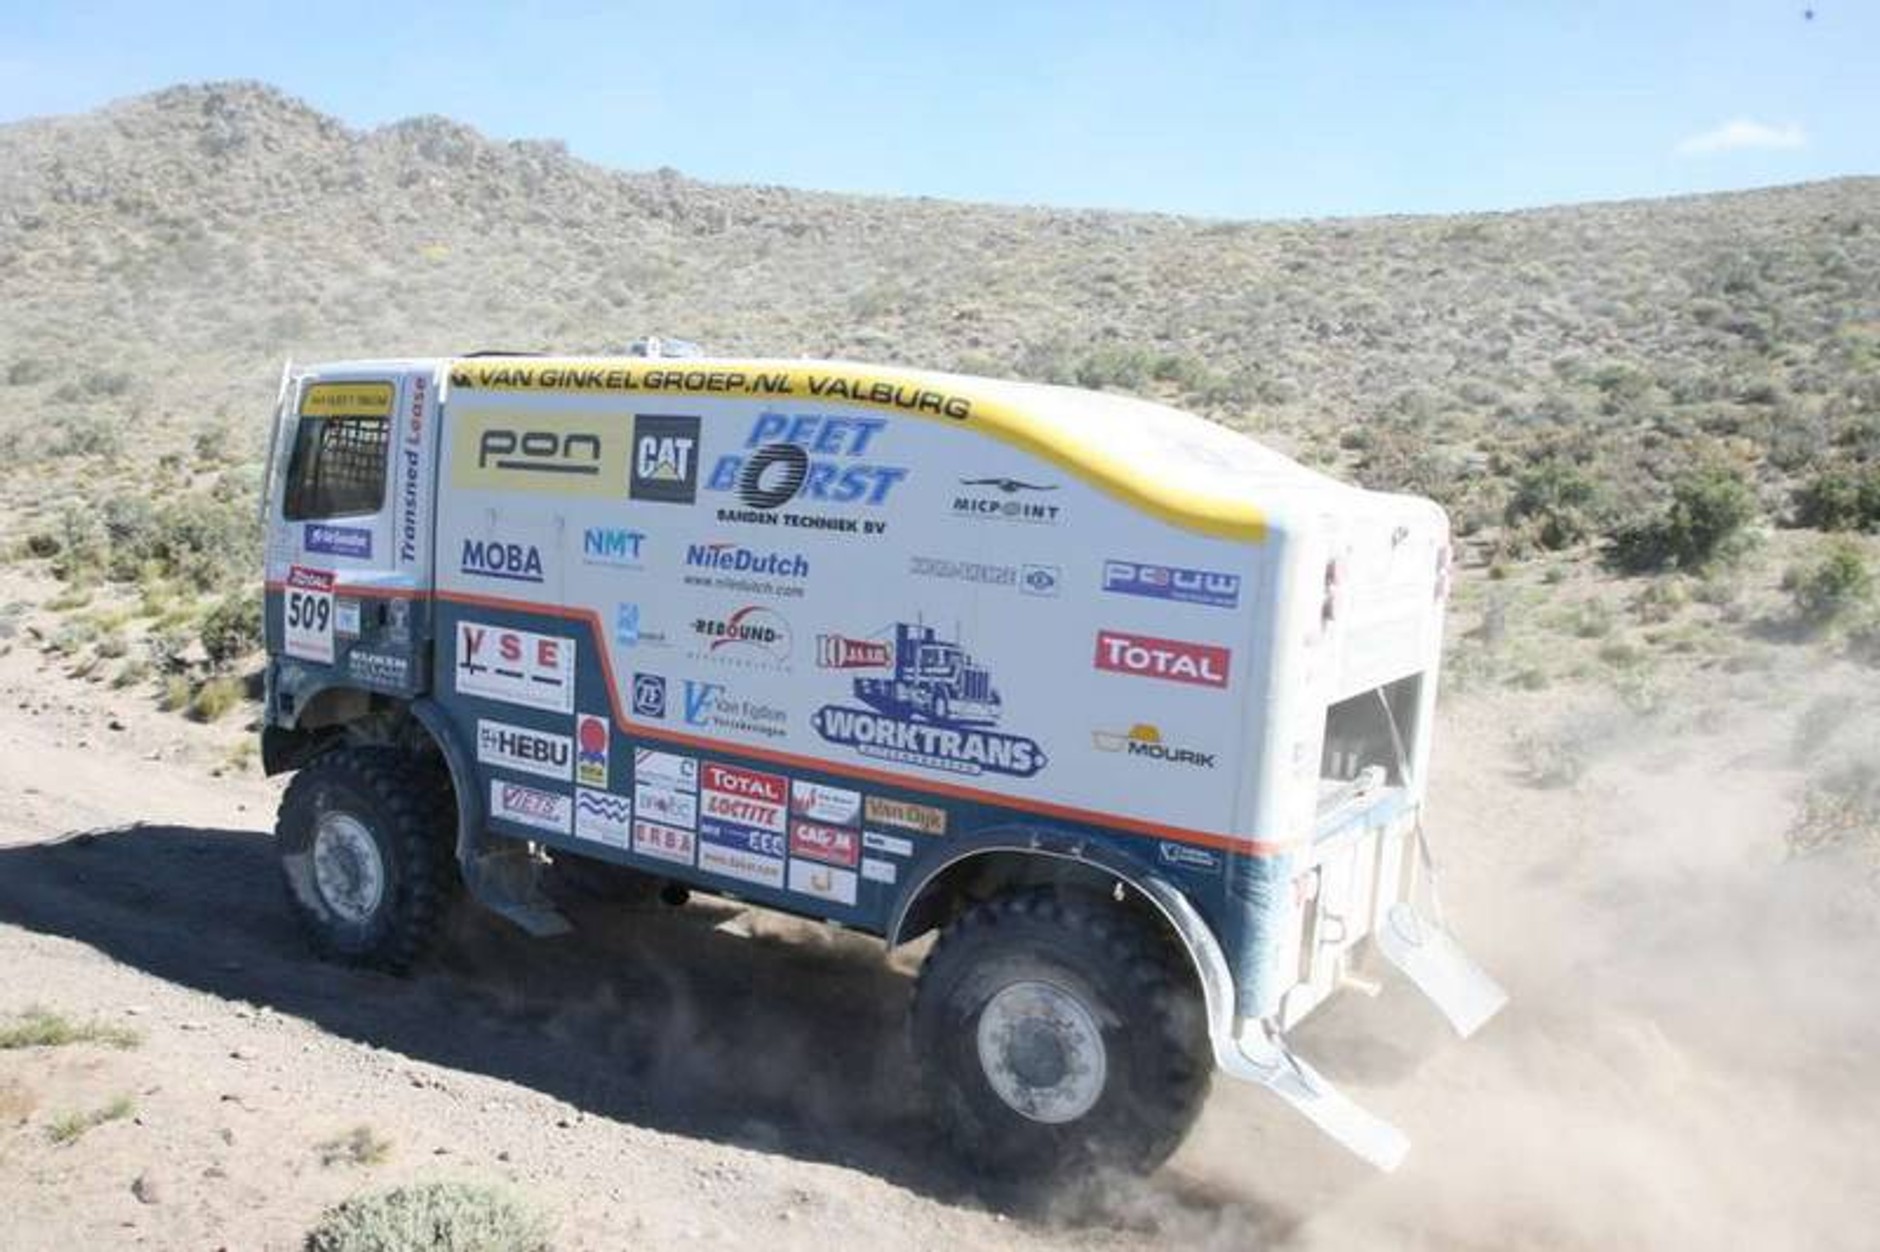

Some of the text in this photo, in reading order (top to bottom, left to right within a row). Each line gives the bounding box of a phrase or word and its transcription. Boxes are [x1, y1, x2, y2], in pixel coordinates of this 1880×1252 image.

[480, 369, 972, 420] VAN GINKEL GROEP.NL VALBURG
[747, 411, 887, 455] PEET
[402, 377, 426, 563] Transned Lease
[637, 436, 694, 482] CAT
[716, 509, 887, 534] BANDEN TECHNIEK BV
[463, 539, 543, 575] MOBA
[584, 529, 646, 557] NMT
[686, 544, 809, 578] NileDutch
[288, 594, 331, 632] 509
[695, 619, 777, 643] REBOUND
[1102, 636, 1224, 682] TOTAL
[499, 730, 568, 766] HEBU
[823, 708, 1033, 772] WORKTRANS
[1128, 741, 1215, 768] MOURIK
[709, 767, 779, 799] TOTAL
[707, 795, 778, 826] LOCTITE
